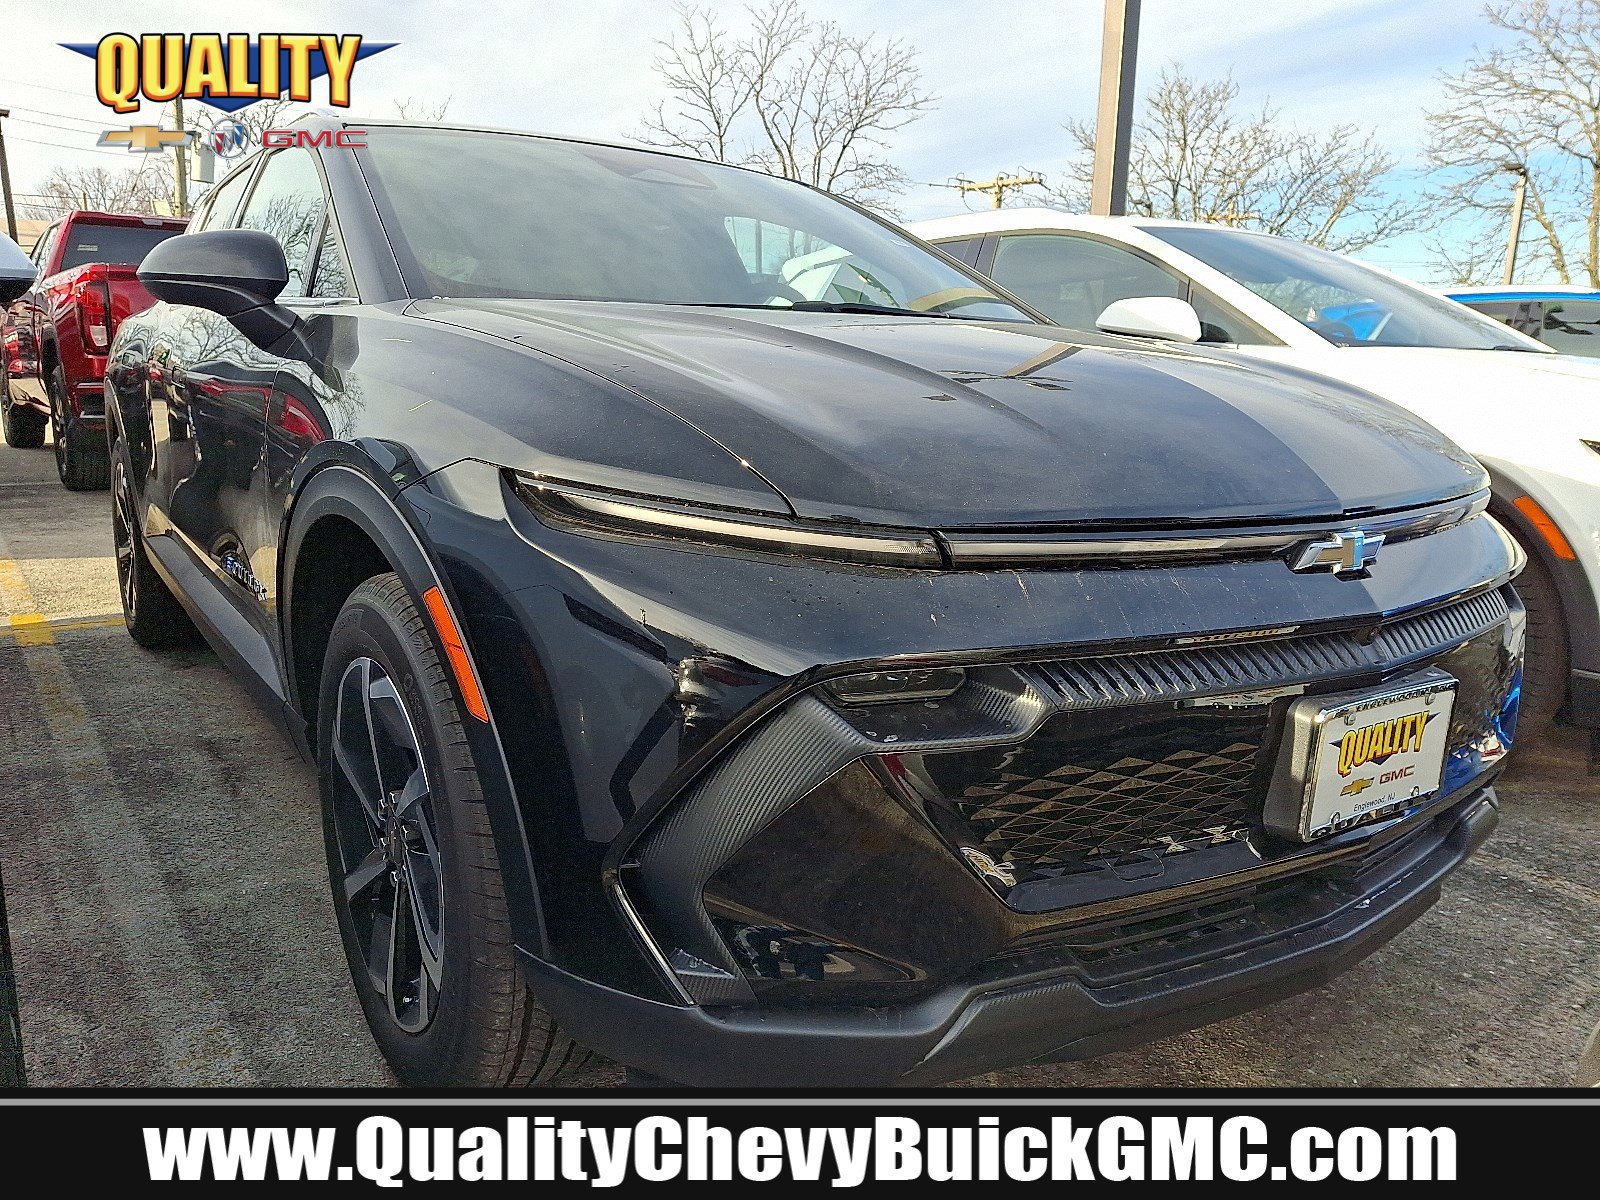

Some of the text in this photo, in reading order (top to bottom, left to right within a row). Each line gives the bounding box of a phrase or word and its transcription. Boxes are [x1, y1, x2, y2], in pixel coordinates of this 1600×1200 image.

[1338, 711, 1430, 777] QUALITY
[1379, 765, 1416, 785] GMC
[1388, 792, 1396, 802] NJ
